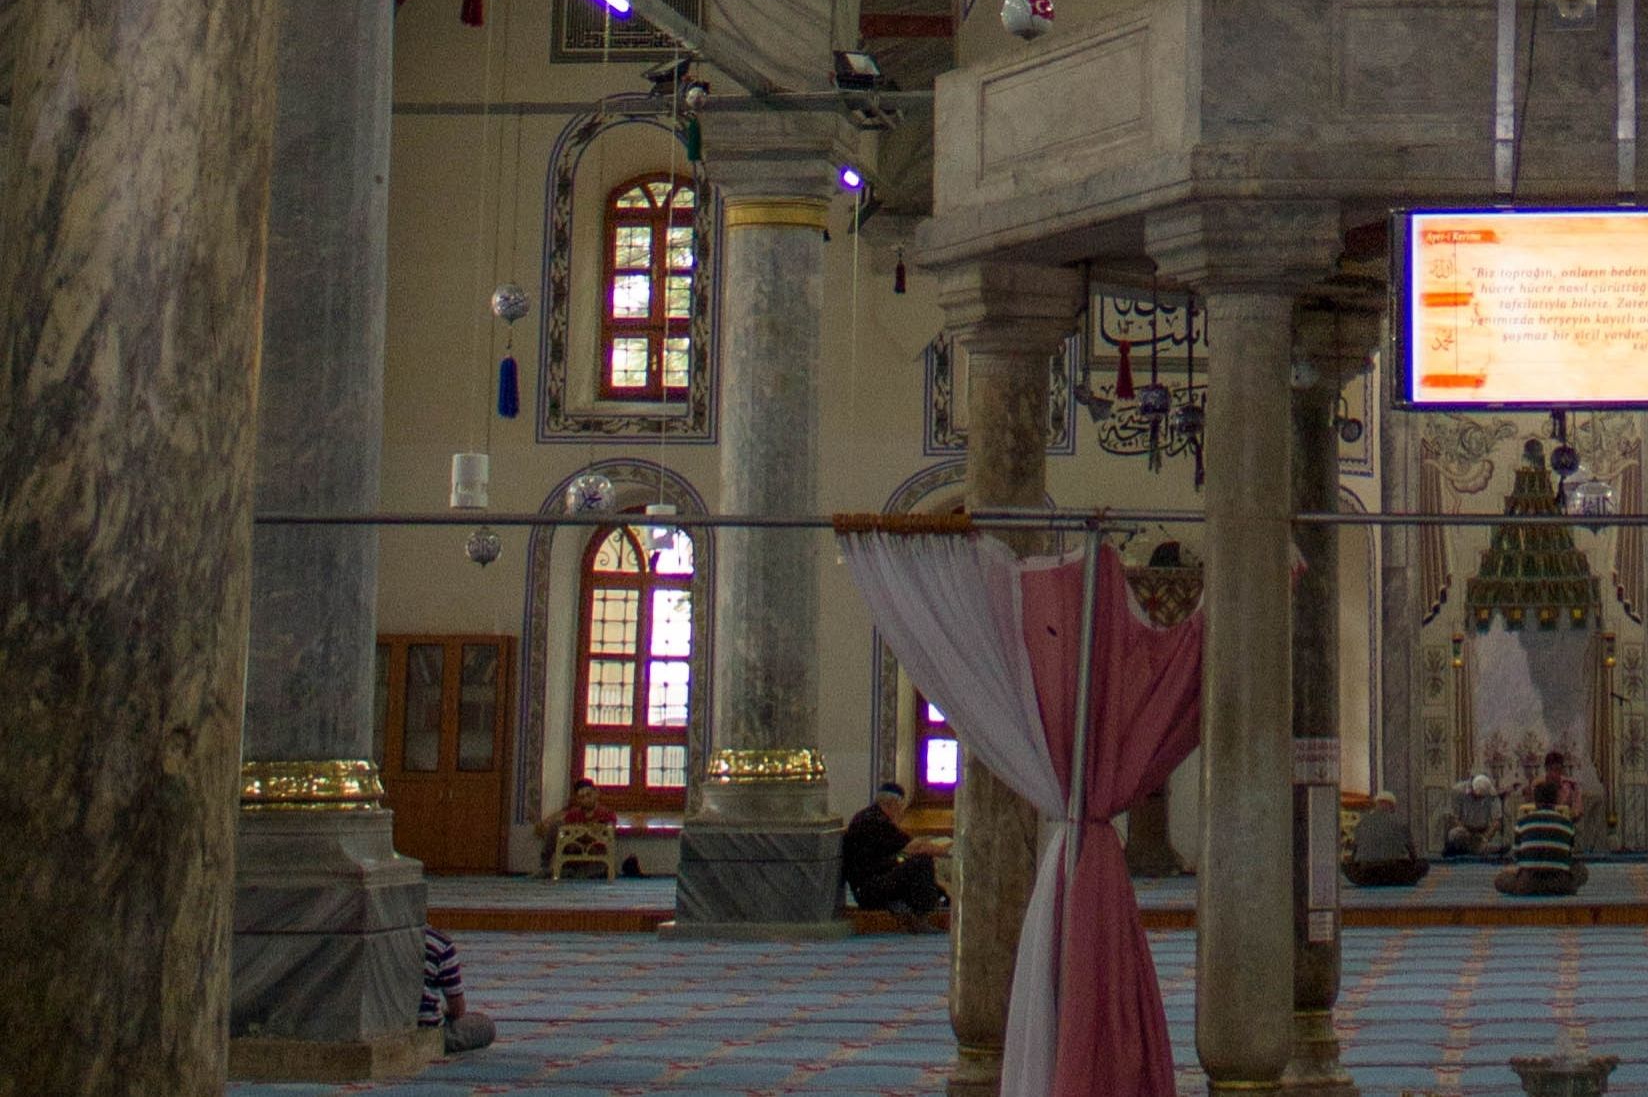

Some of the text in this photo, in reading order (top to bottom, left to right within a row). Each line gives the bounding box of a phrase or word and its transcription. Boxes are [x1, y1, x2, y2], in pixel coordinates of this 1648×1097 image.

[1561, 265, 1607, 279] onların
[1480, 282, 1515, 294] hücre
[1519, 282, 1554, 294] hücre
[1558, 282, 1589, 294] nasıl
[1538, 314, 1591, 328] herşeyin
[1595, 313, 1635, 326] kayıtlı
[1552, 329, 1570, 341] bir
[1574, 329, 1600, 341] sicil
